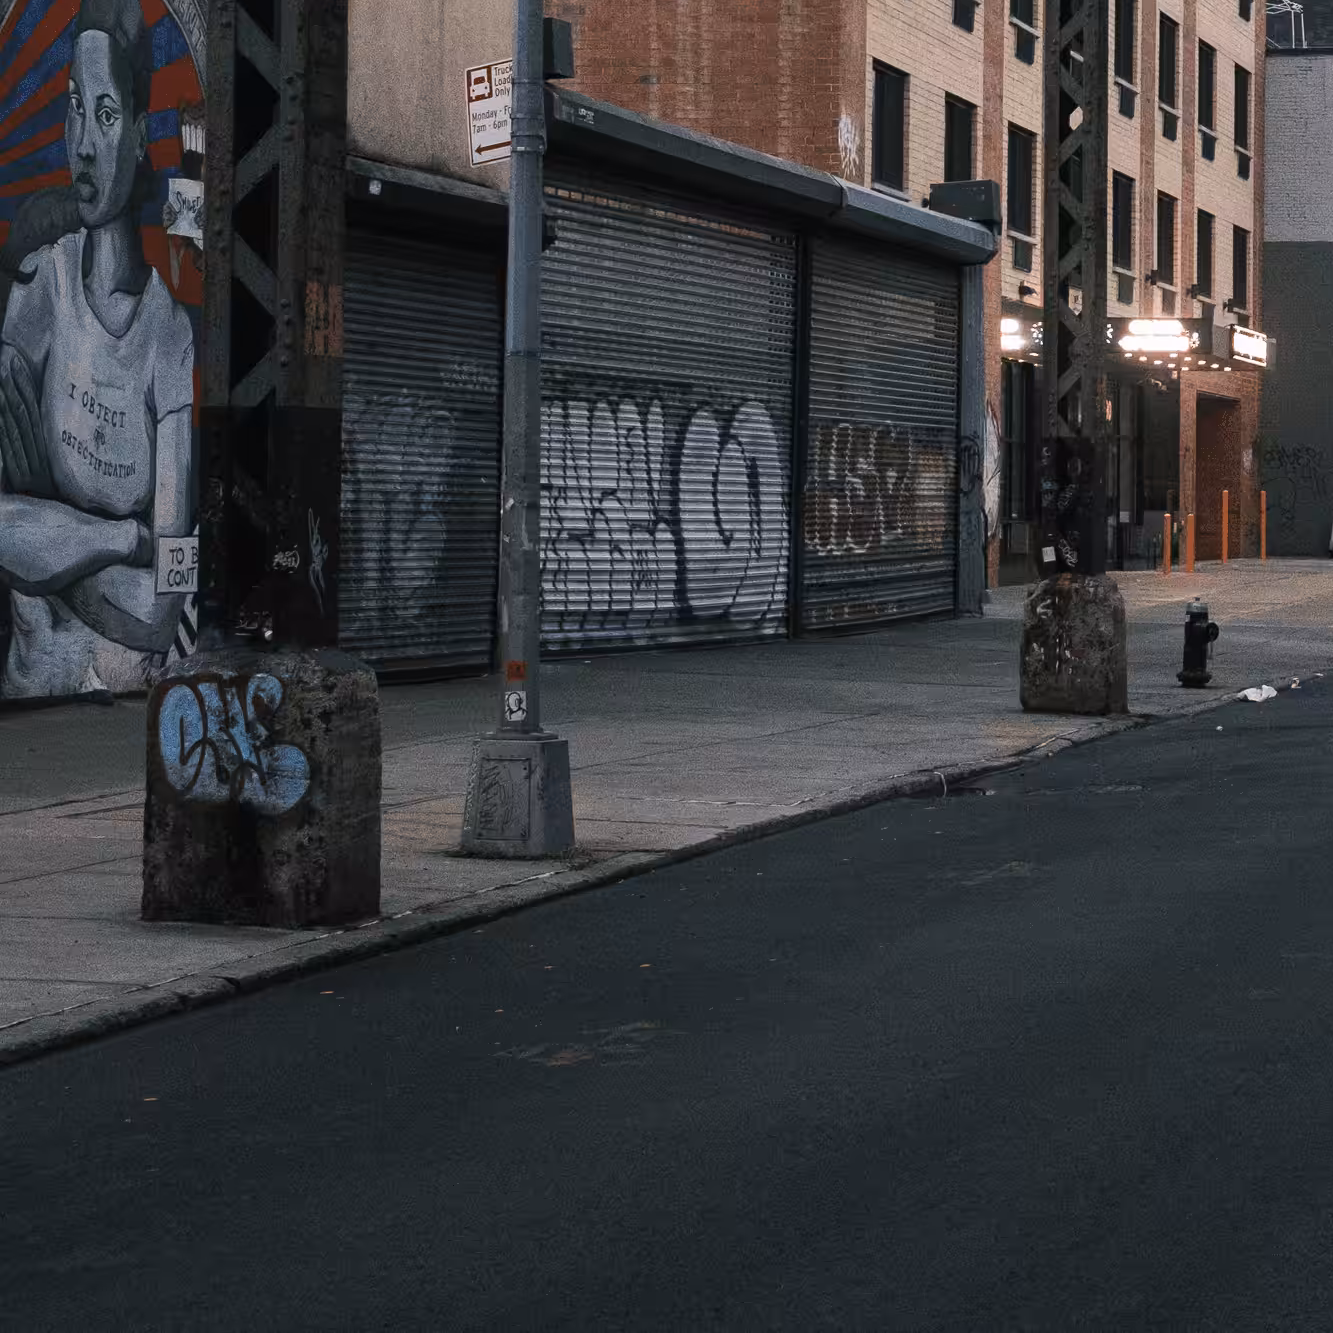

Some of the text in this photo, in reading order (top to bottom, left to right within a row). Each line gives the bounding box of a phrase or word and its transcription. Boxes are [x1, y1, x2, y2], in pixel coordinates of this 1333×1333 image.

[494, 86, 510, 97] Only
[472, 110, 498, 122] Monday
[472, 124, 487, 135] 7am
[493, 119, 508, 130] 6pm
[68, 383, 126, 428] I OBJECT
[169, 547, 185, 565] TO
[167, 567, 197, 587] CONT
